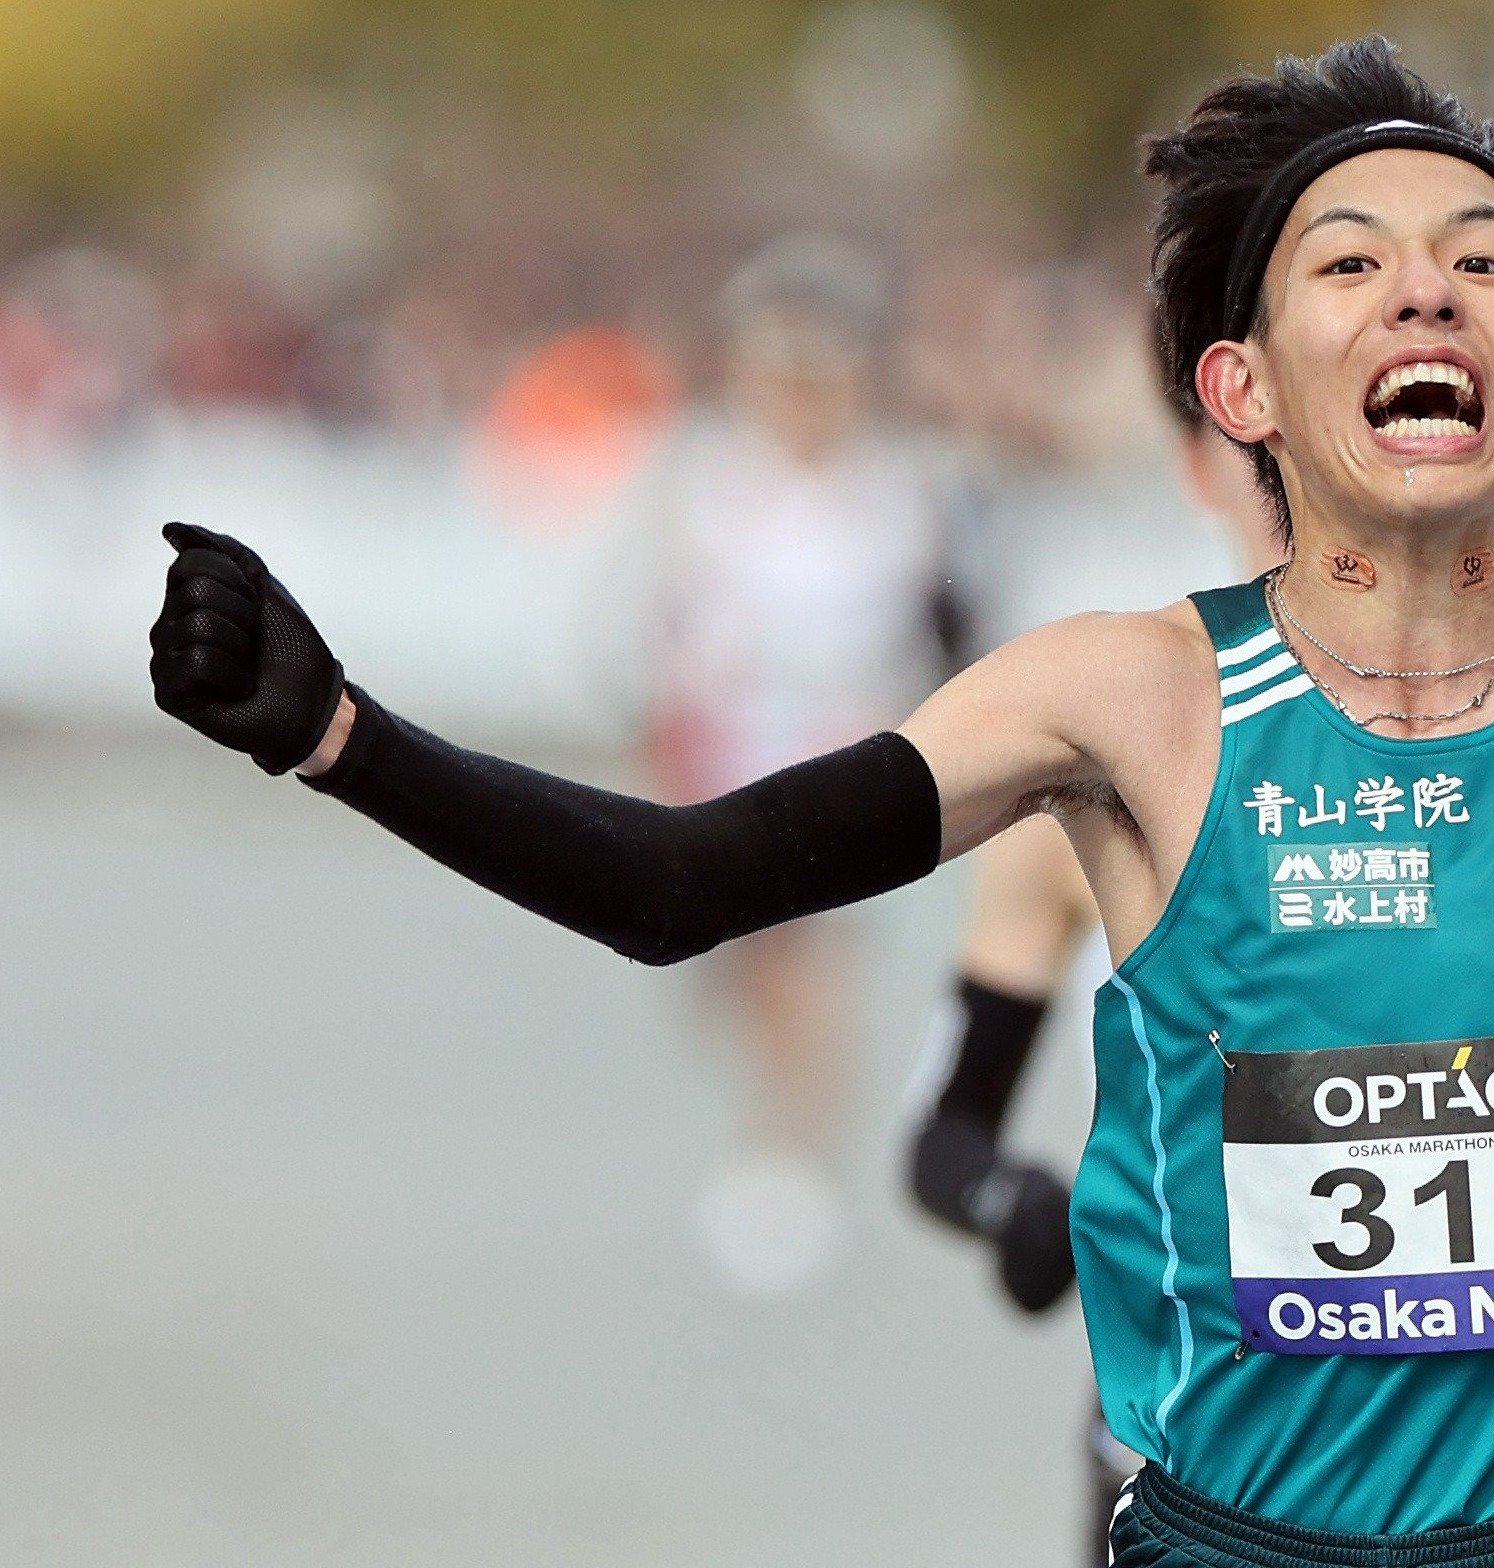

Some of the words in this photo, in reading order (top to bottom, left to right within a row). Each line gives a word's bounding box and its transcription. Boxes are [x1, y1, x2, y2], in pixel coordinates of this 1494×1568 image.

[1243, 773, 1470, 837] 青山学院
[1328, 848, 1430, 882] 妙高市
[1322, 889, 1428, 925] 水上村
[1348, 1142, 1403, 1158] OSAKA
[1268, 1288, 1458, 1341] Osaka
